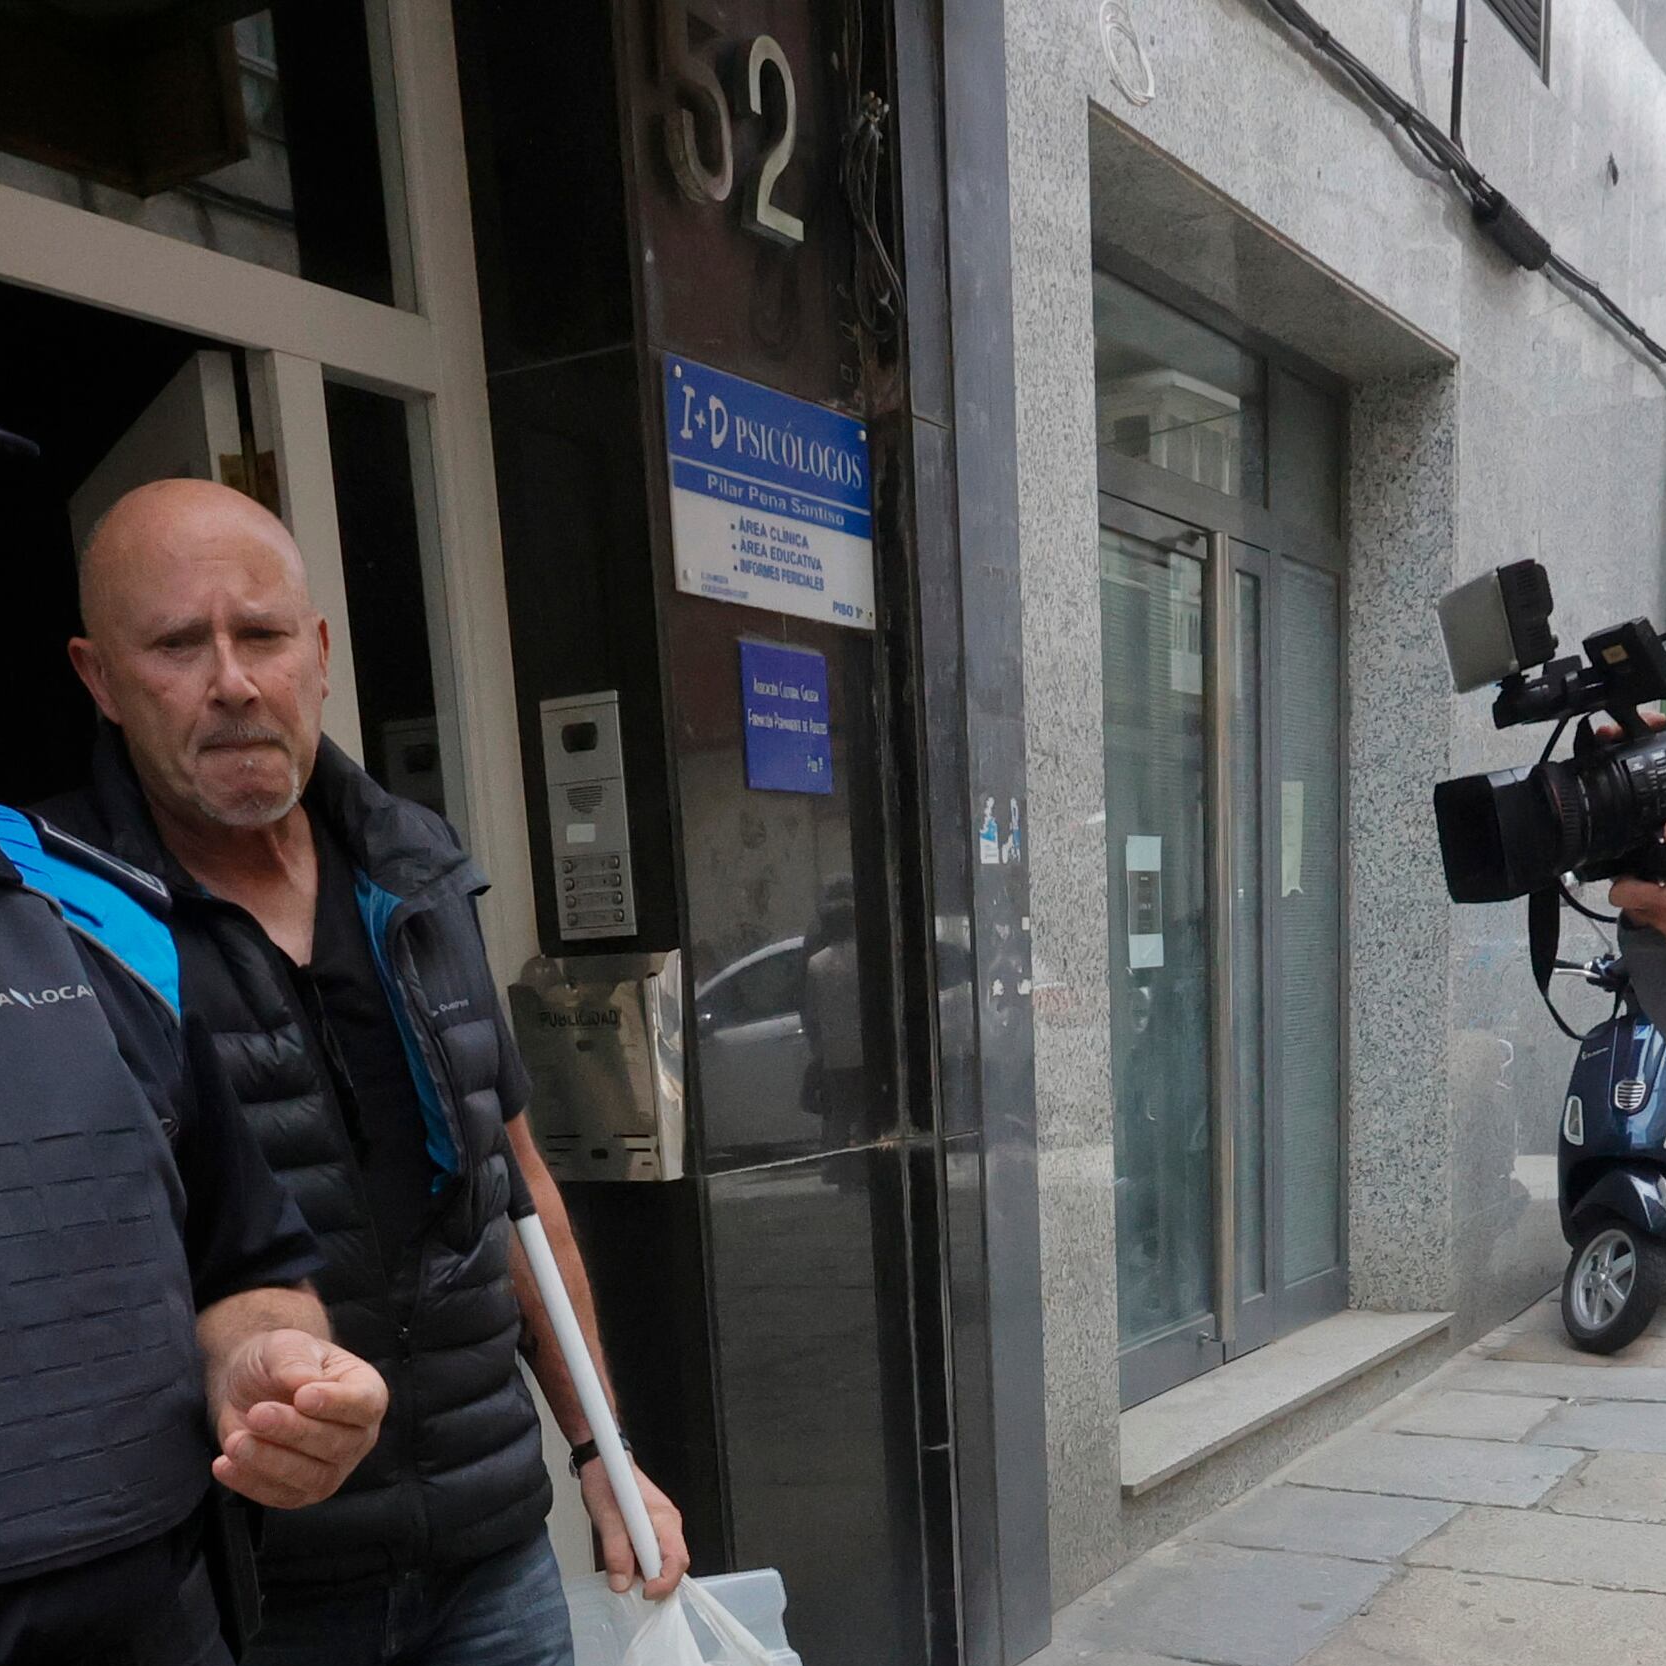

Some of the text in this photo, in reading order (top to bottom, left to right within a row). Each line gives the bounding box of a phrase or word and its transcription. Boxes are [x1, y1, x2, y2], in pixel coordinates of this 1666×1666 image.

[665, 1, 804, 243] 52
[735, 416, 863, 489] PSICÓLOGOS
[707, 473, 744, 498] Pilar
[769, 526, 810, 549] CLÍNICA
[740, 559, 781, 582] INFORMES
[770, 547, 823, 571] EDUCATIVA
[28, 984, 94, 1005] LOCA
